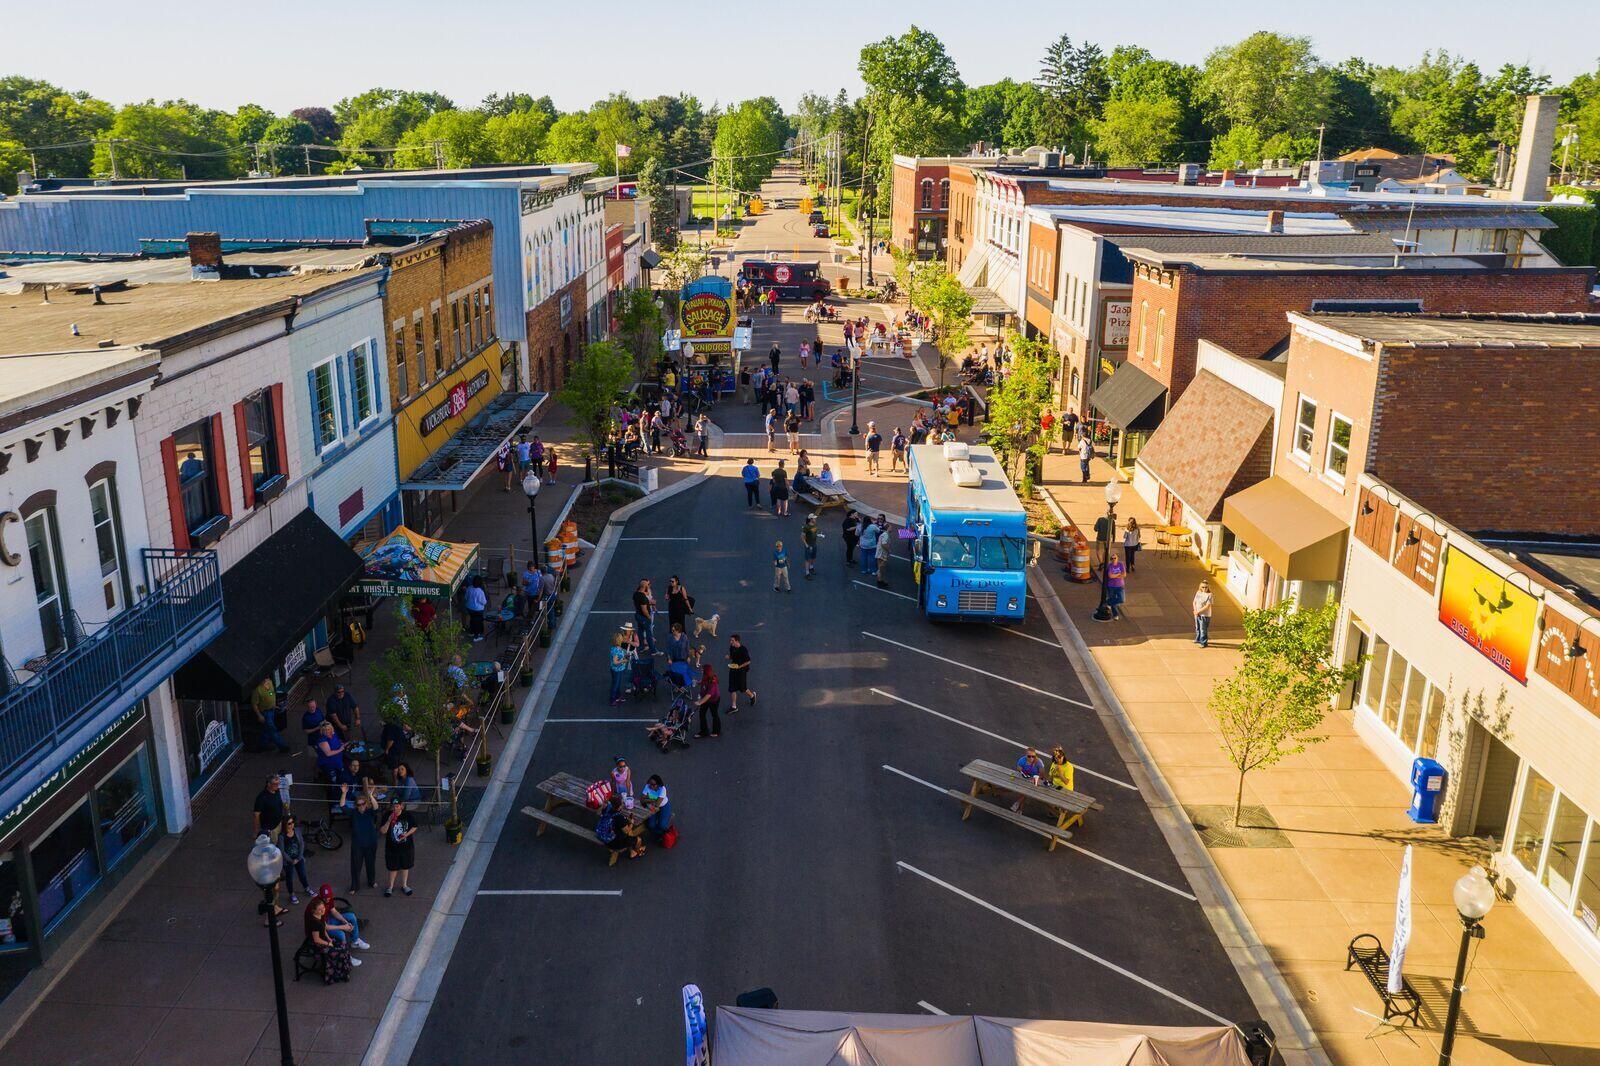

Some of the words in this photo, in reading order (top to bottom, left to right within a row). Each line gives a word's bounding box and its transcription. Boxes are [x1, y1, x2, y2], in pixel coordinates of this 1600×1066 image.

[686, 309, 726, 325] SAUSAGE
[363, 585, 395, 594] WHISTLE
[396, 586, 441, 596] BREWHOUSE
[1451, 617, 1469, 638] RISE
[1491, 647, 1511, 670] DINE
